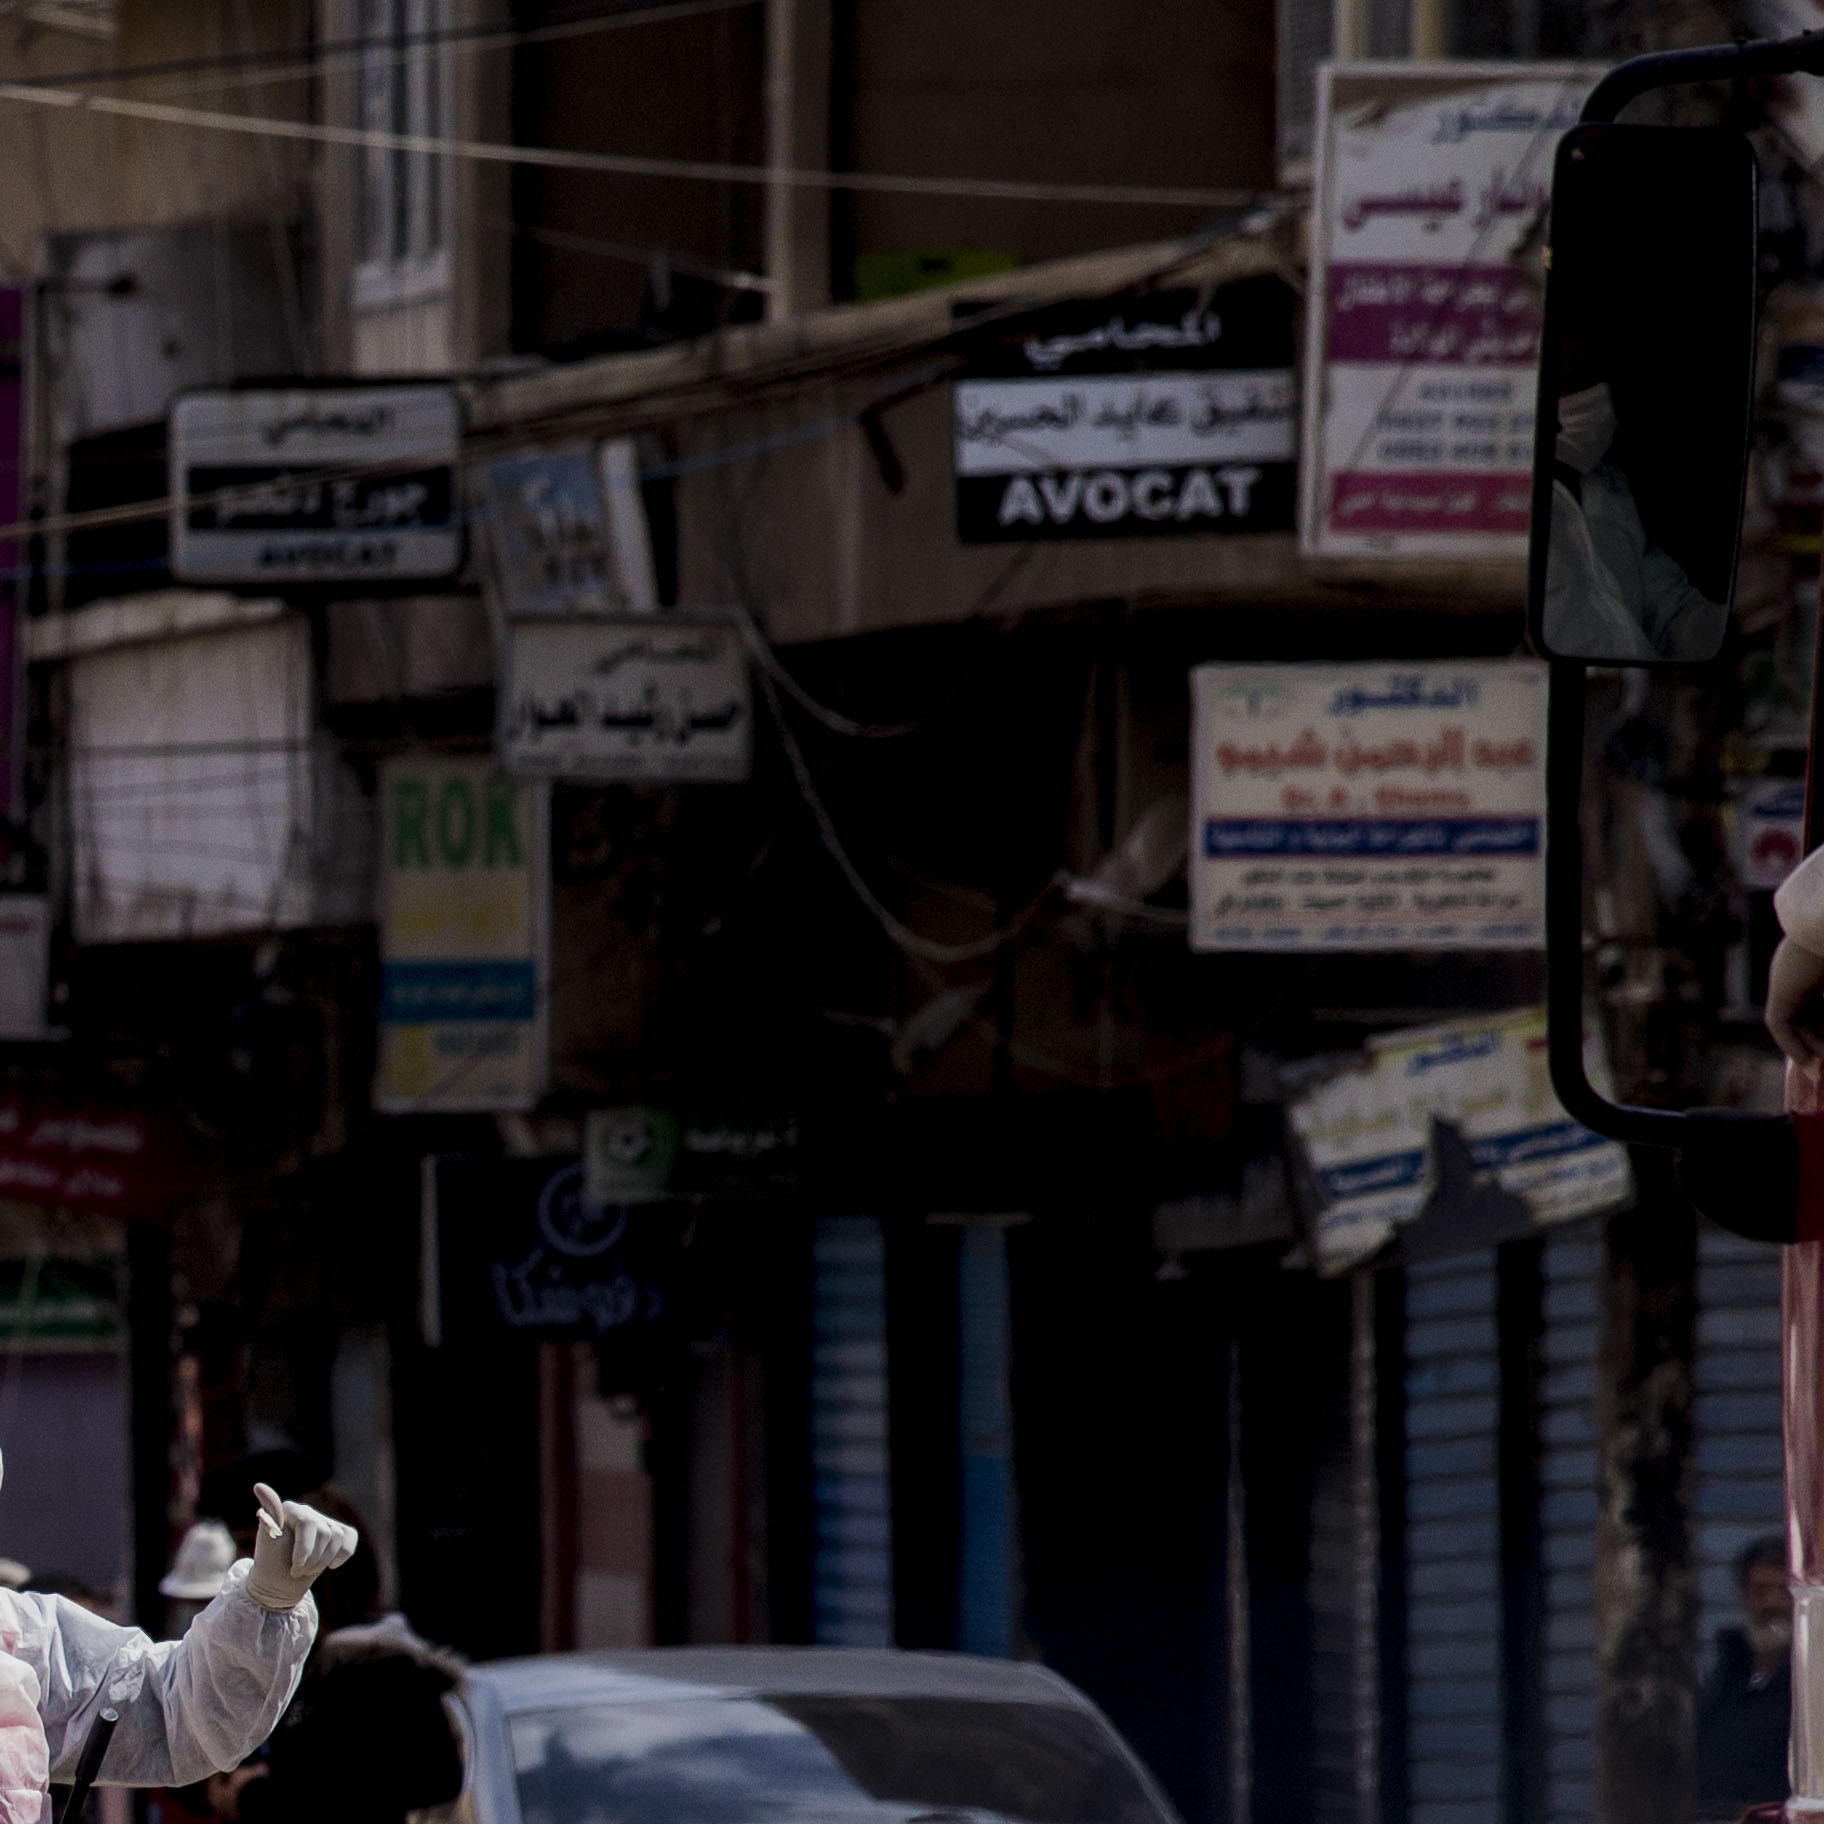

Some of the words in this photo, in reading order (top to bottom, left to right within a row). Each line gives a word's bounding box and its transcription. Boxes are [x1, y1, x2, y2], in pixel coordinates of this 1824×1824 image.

[1022, 310, 1225, 371] المحامي
[996, 465, 1264, 528] AVOCAT
[1326, 675, 1481, 717] الدكتور
